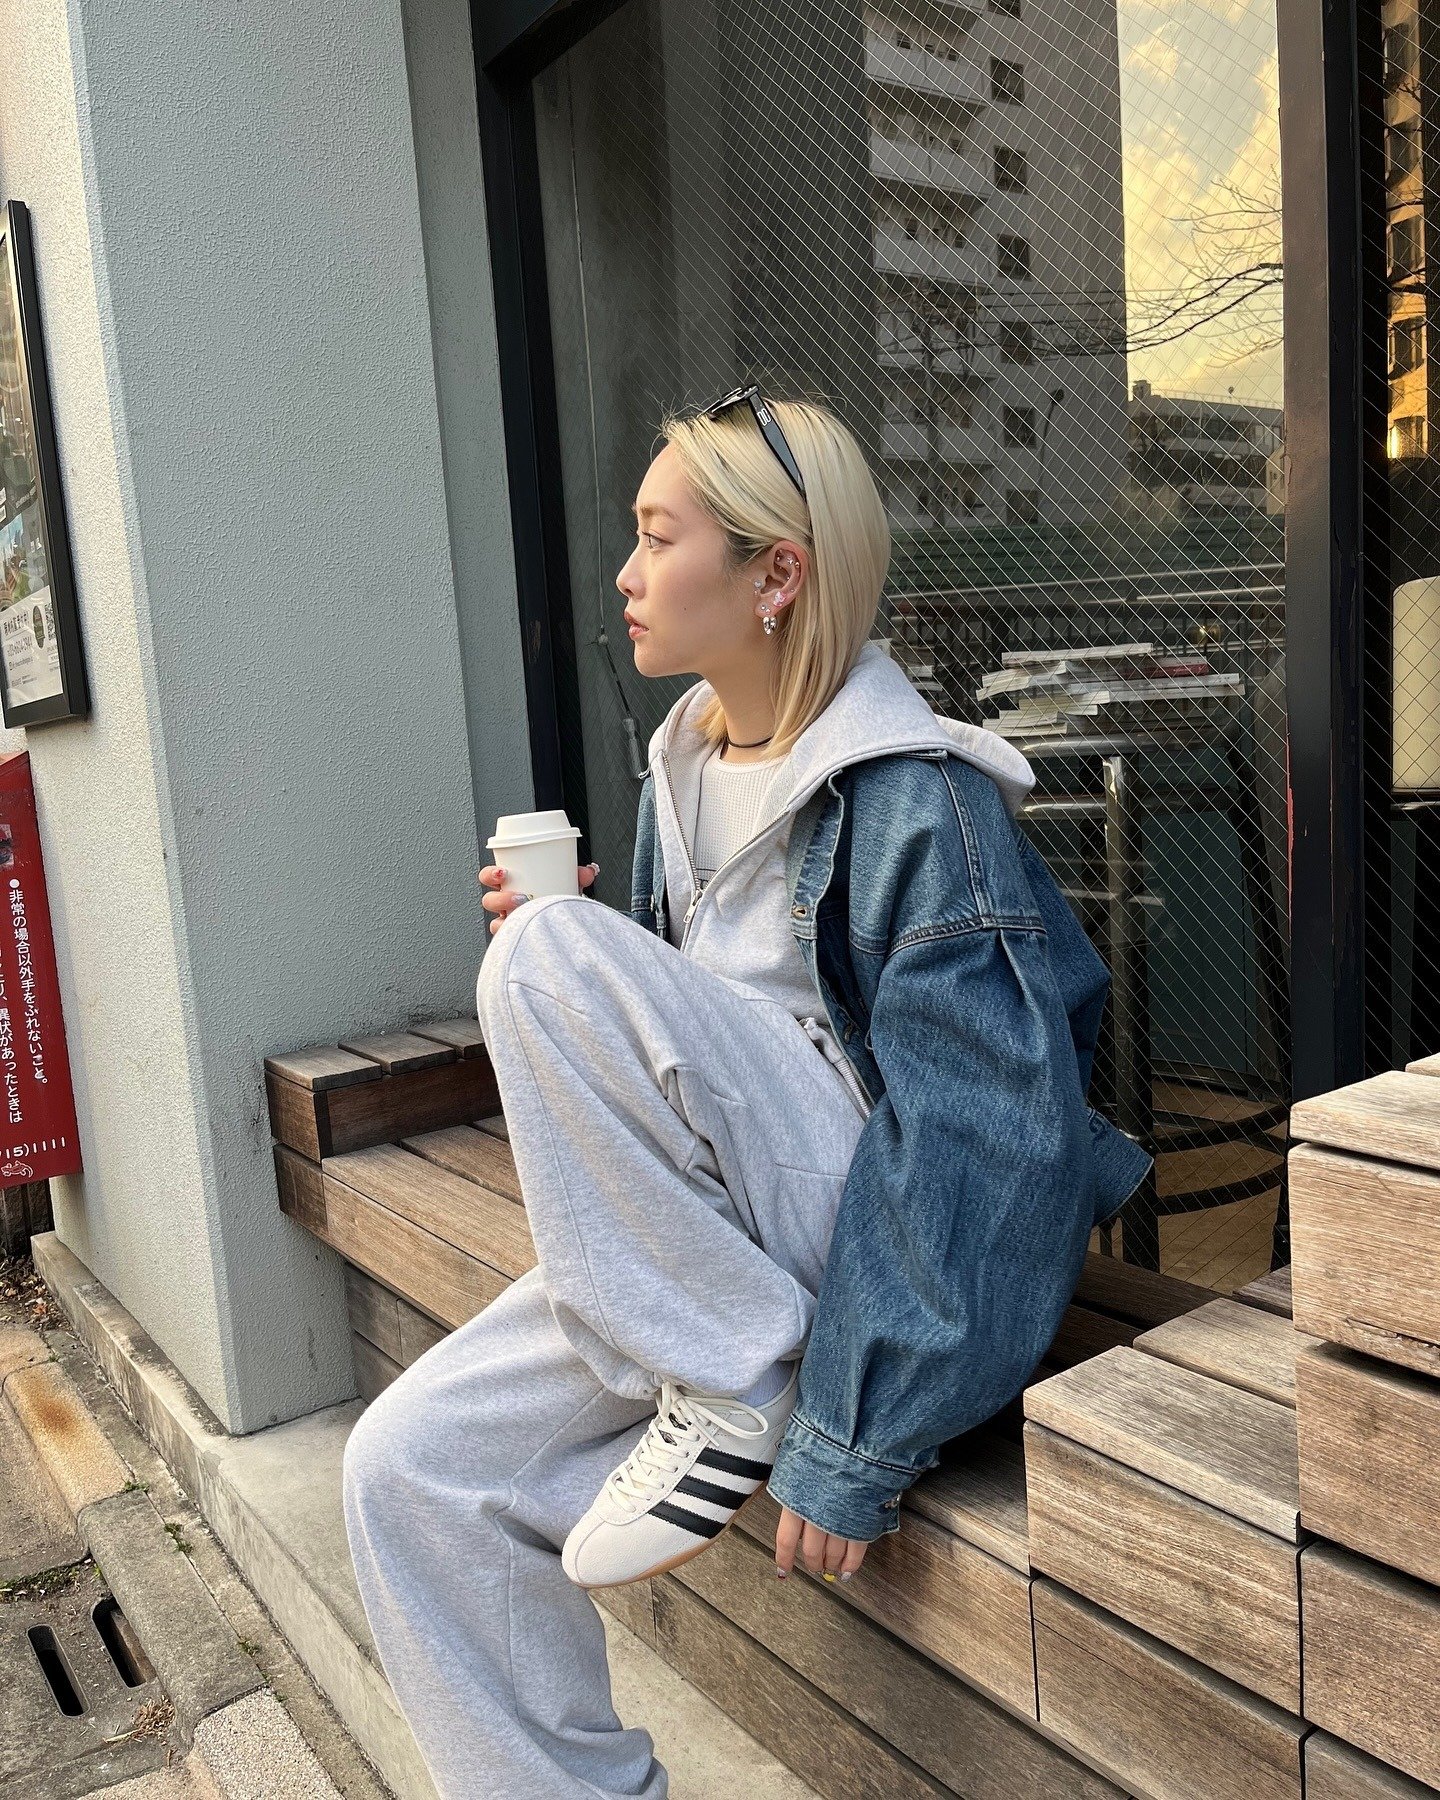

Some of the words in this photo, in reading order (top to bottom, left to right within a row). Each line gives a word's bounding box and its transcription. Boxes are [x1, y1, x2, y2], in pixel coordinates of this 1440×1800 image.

[9, 889, 47, 1083] 非常の場合以外手をふれないこと。
[0, 1136, 65, 1159] 15)1111
